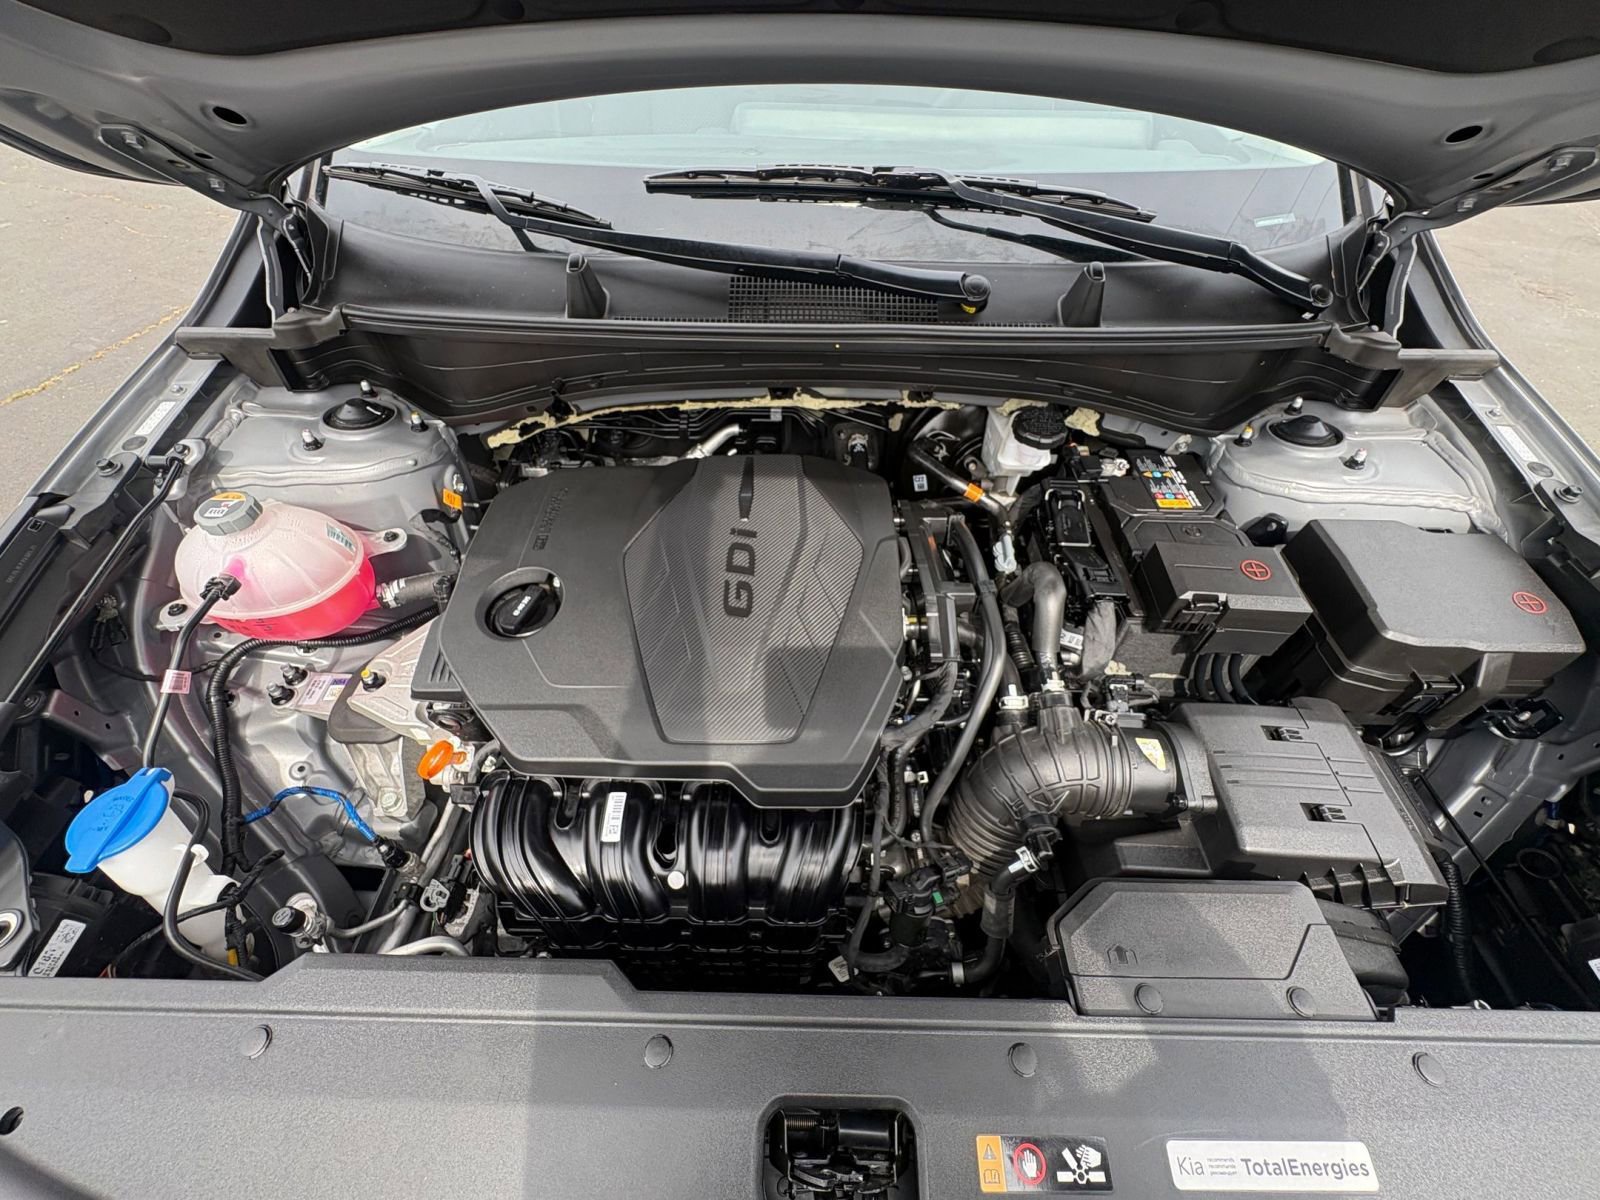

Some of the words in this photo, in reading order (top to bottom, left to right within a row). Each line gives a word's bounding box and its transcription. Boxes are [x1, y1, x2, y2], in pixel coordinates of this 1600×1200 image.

[722, 527, 758, 618] GDi
[1176, 1156, 1205, 1176] Kia
[1240, 1157, 1370, 1181] TotalEnergies
